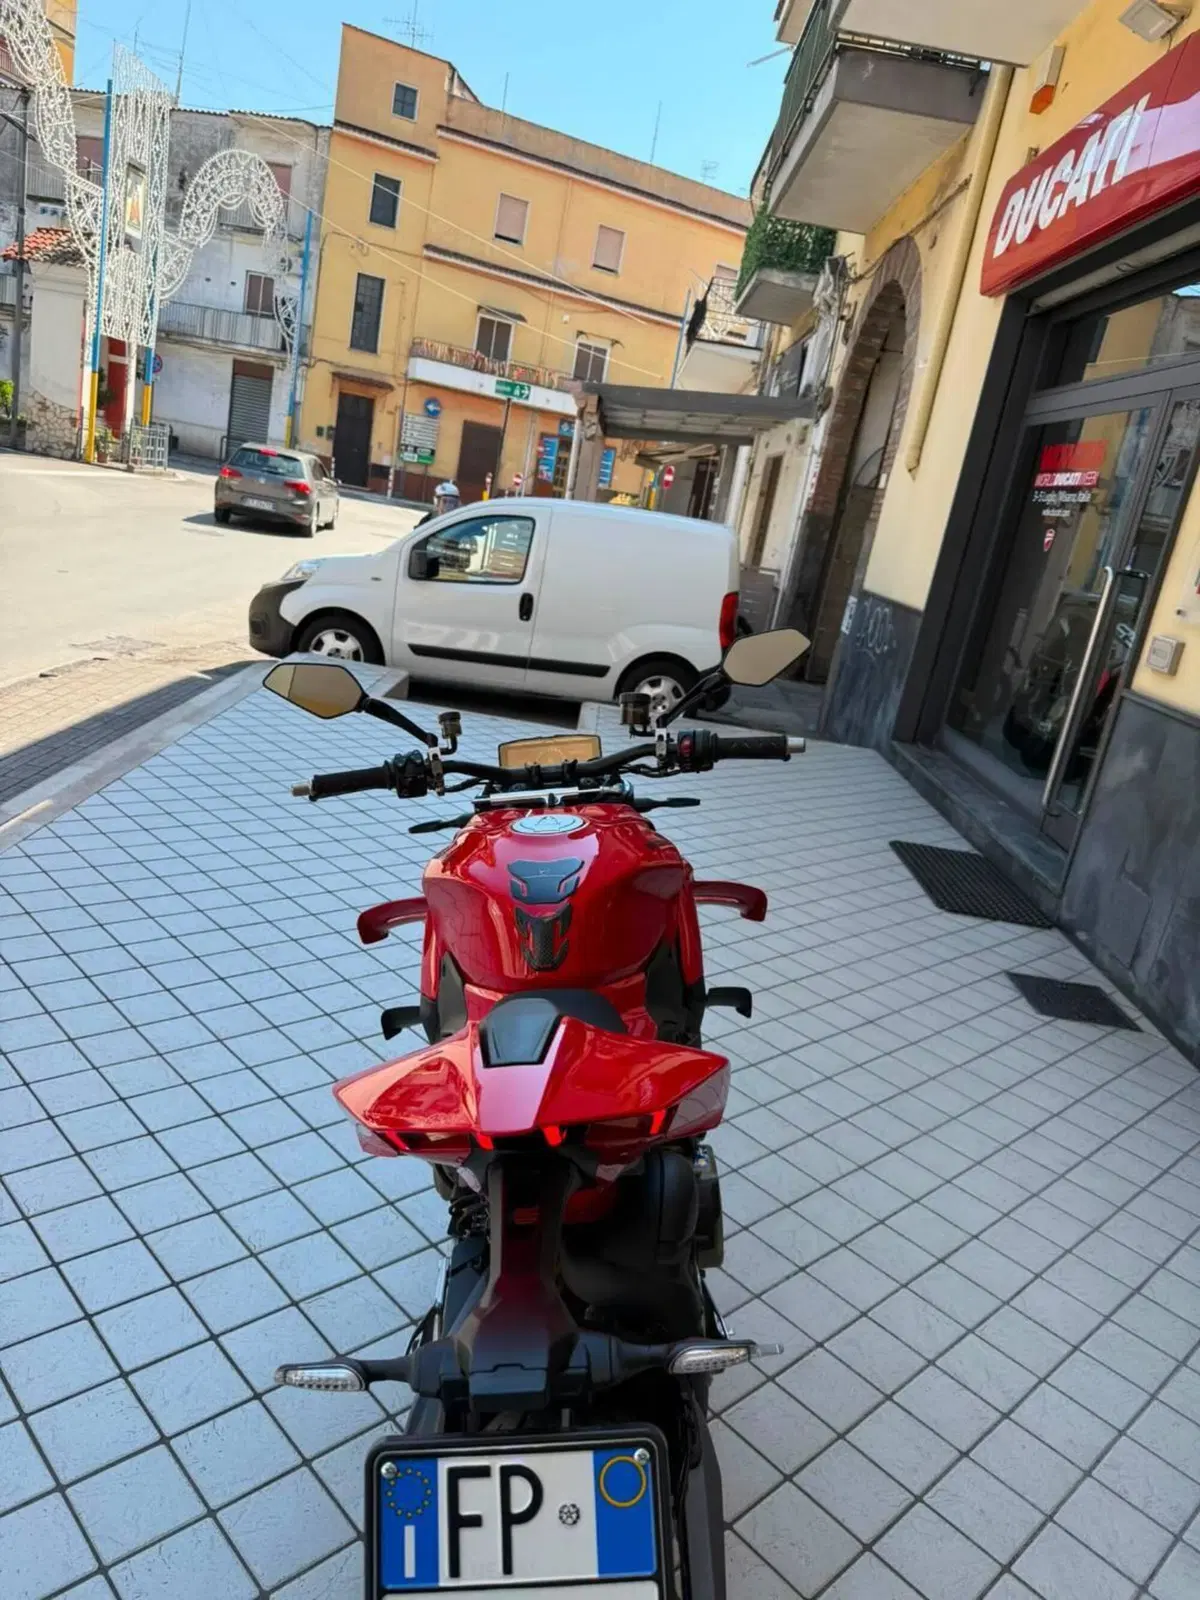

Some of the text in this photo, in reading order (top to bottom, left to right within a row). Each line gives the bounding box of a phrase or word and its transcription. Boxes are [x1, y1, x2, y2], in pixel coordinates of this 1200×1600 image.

[993, 92, 1152, 258] DUCATI
[404, 1525, 416, 1578] I
[447, 1464, 544, 1578] FP
